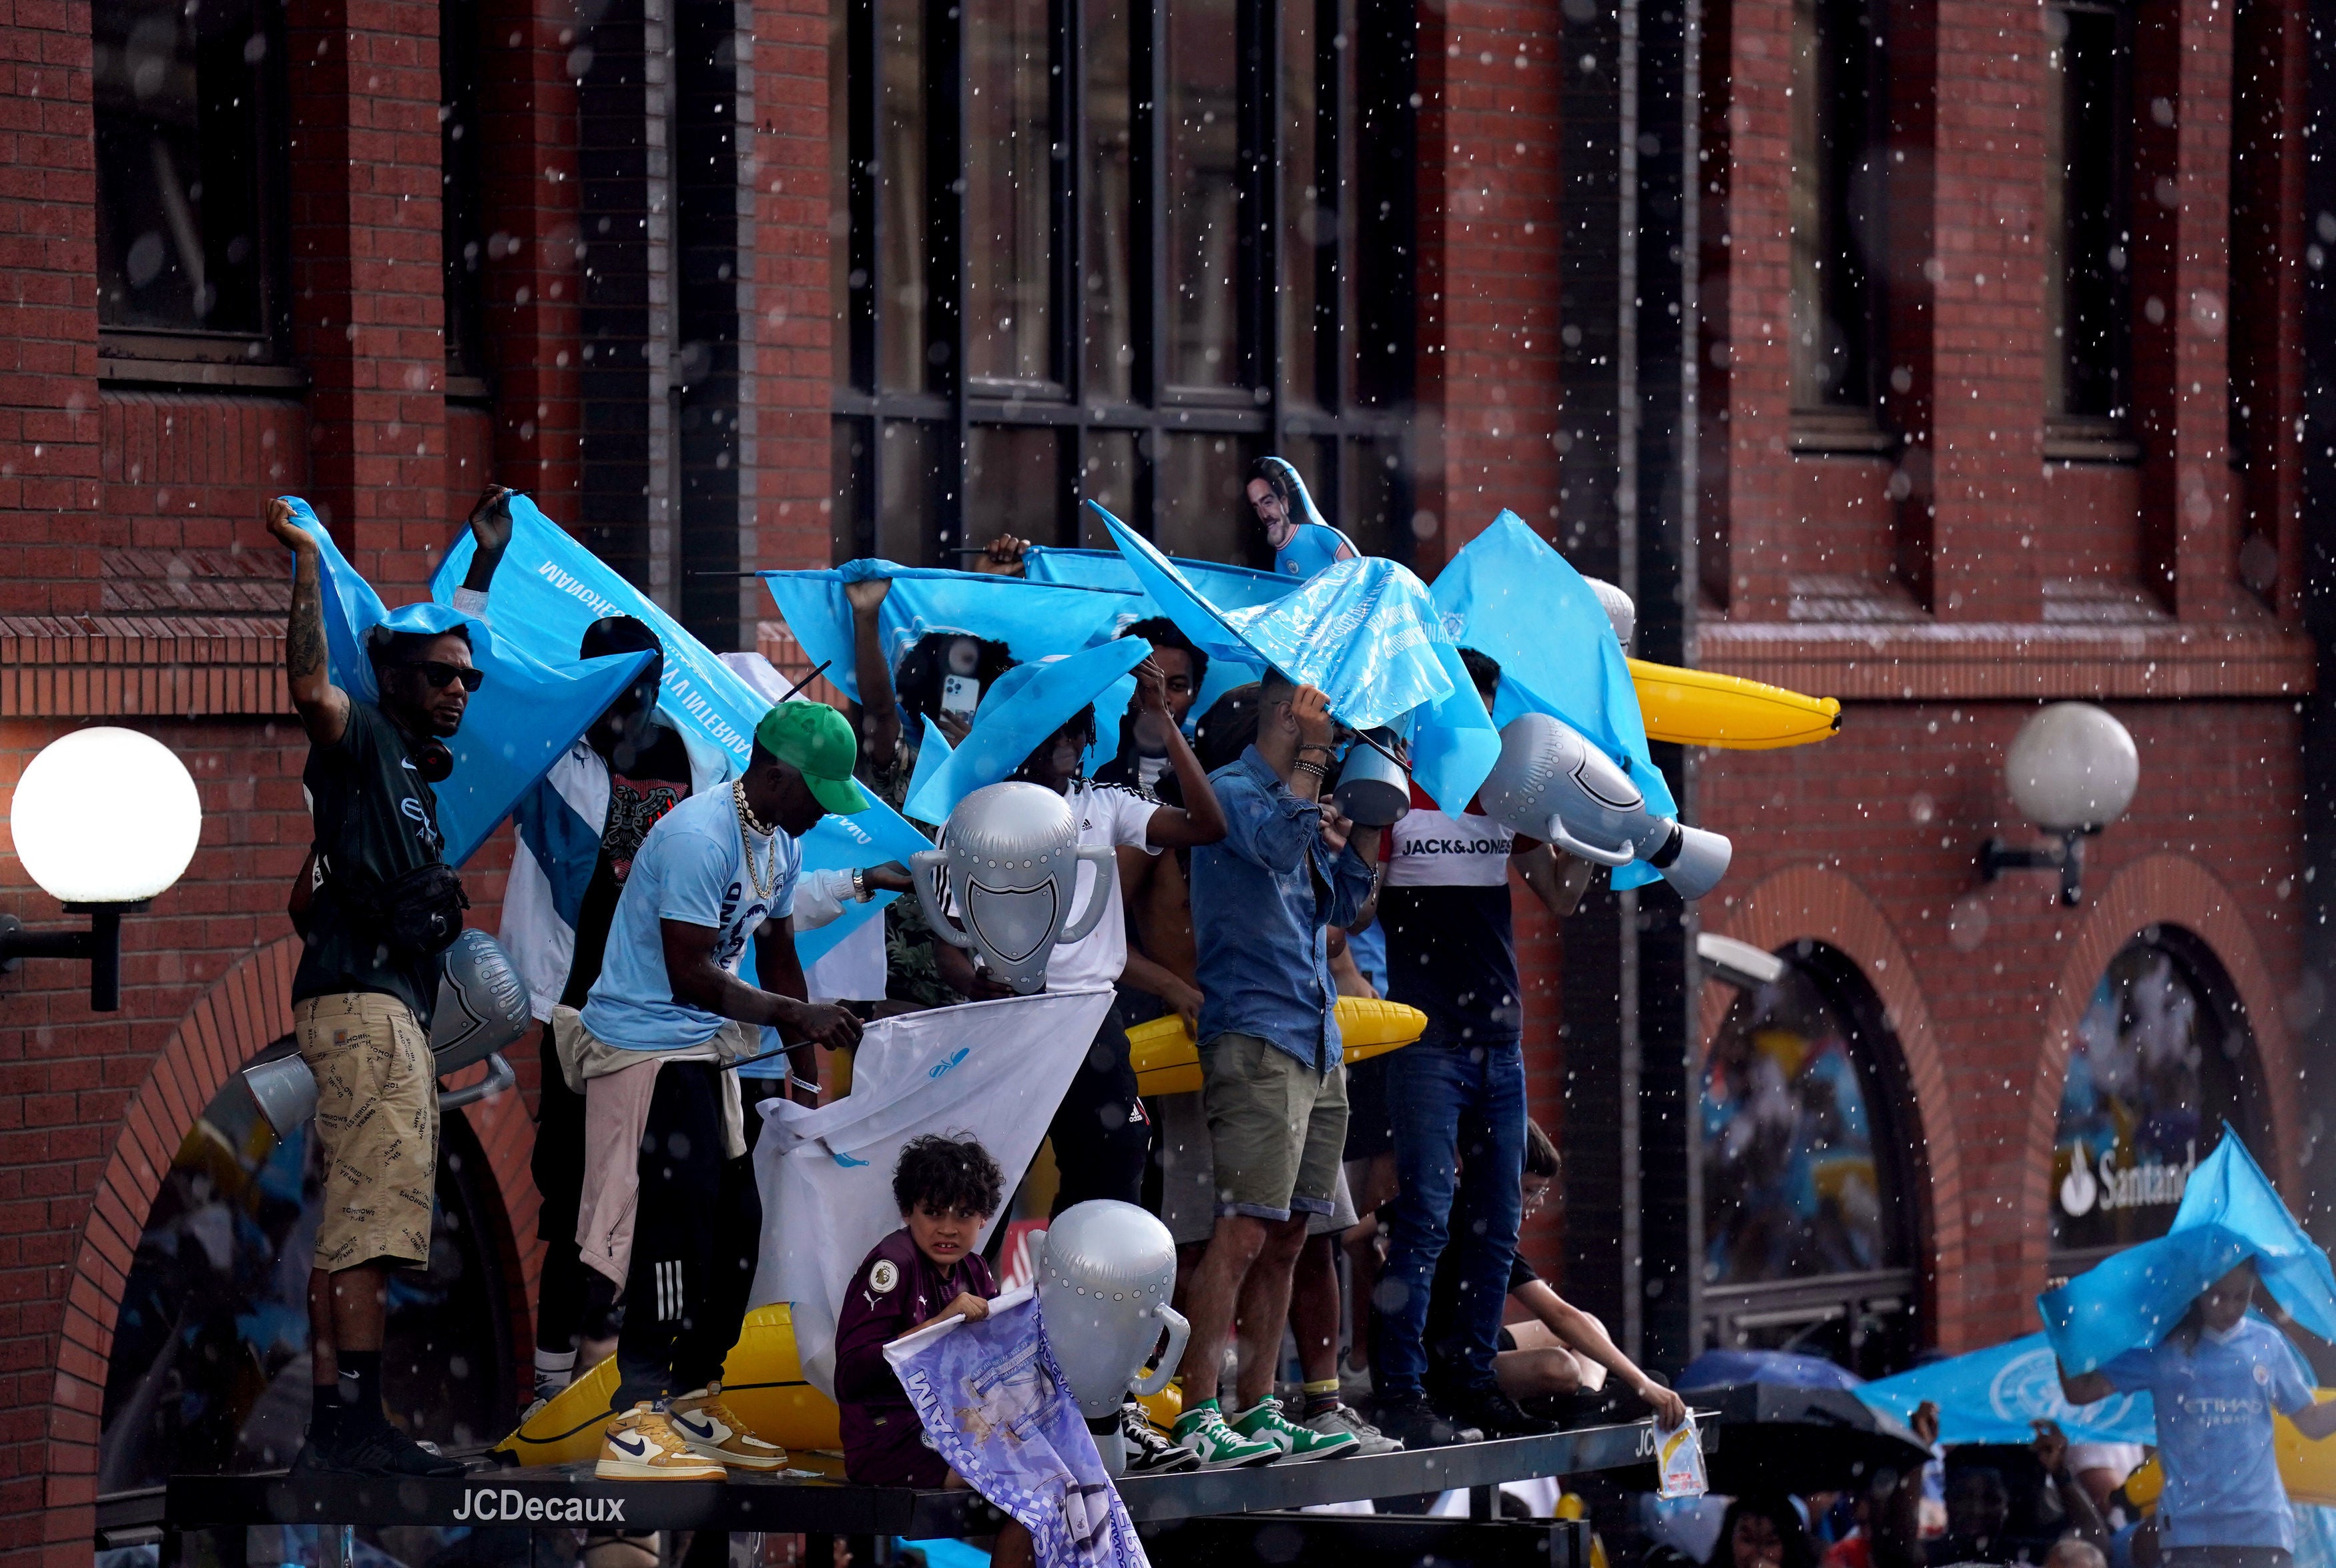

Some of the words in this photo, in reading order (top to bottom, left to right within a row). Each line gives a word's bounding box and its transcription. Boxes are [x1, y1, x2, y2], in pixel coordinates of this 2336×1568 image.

[1402, 839, 1512, 856] JACK&JONES
[1129, 1114, 1143, 1122] adidas
[2099, 1137, 2197, 1211] Santand
[2184, 1397, 2263, 1415] ETIHAD
[453, 1489, 626, 1523] JCDecaux
